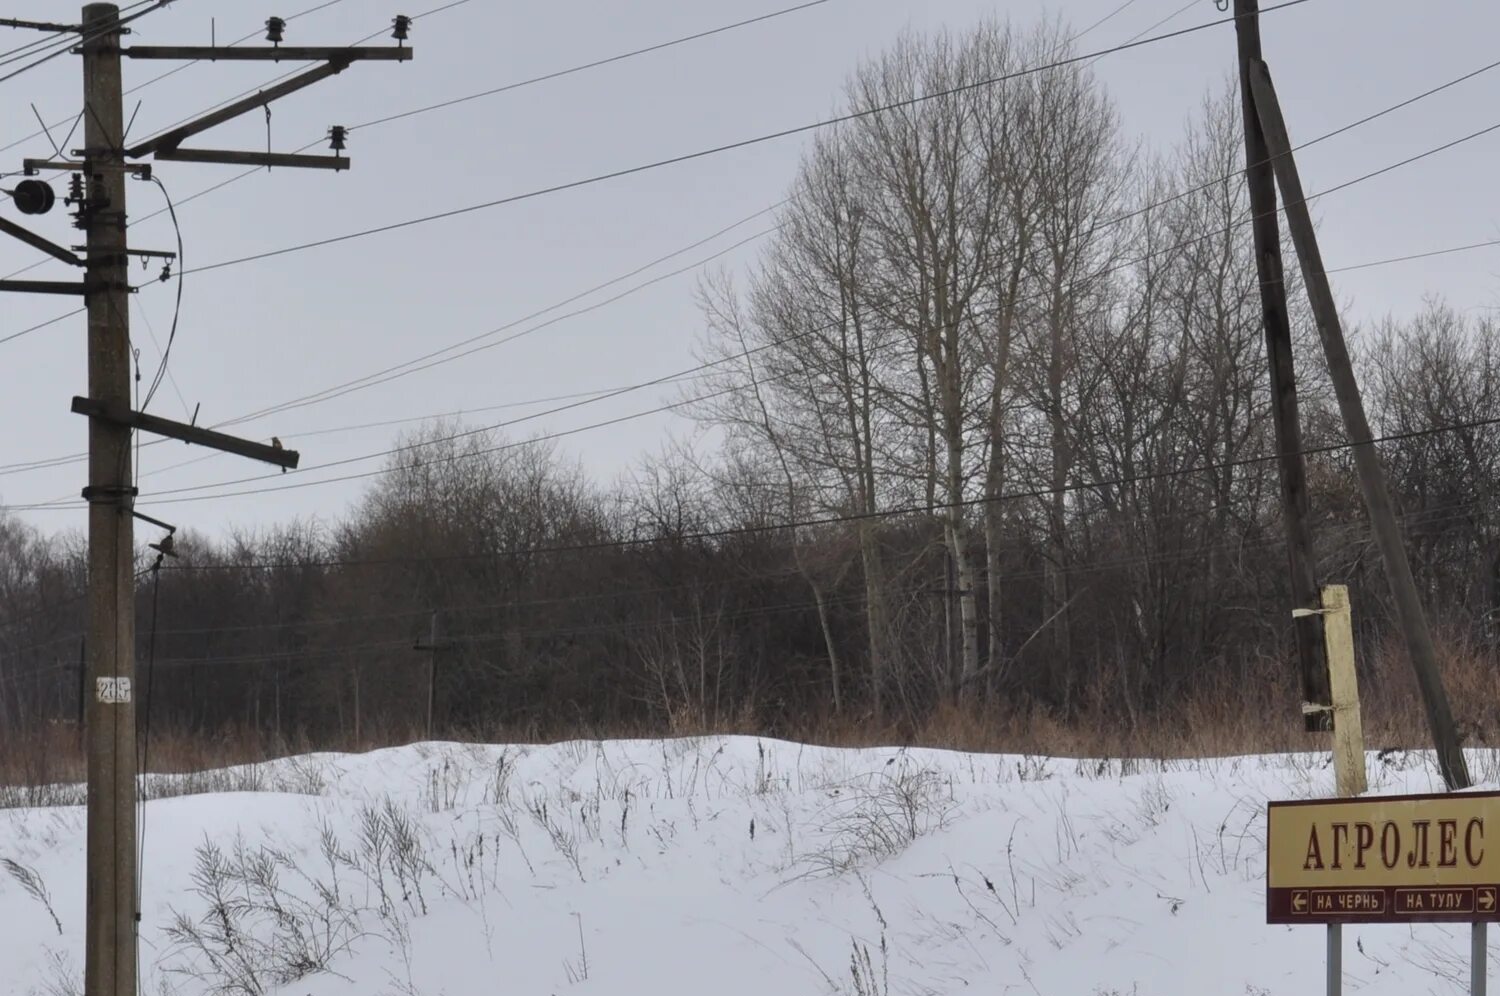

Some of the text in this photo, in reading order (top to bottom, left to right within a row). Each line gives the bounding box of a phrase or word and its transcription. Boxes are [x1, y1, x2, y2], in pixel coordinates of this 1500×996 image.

[1303, 816, 1485, 870] АГРОЛЕС
[1316, 893, 1379, 908] НА ЧЕРНЬ
[1406, 893, 1463, 908] НА ТУЛУ
